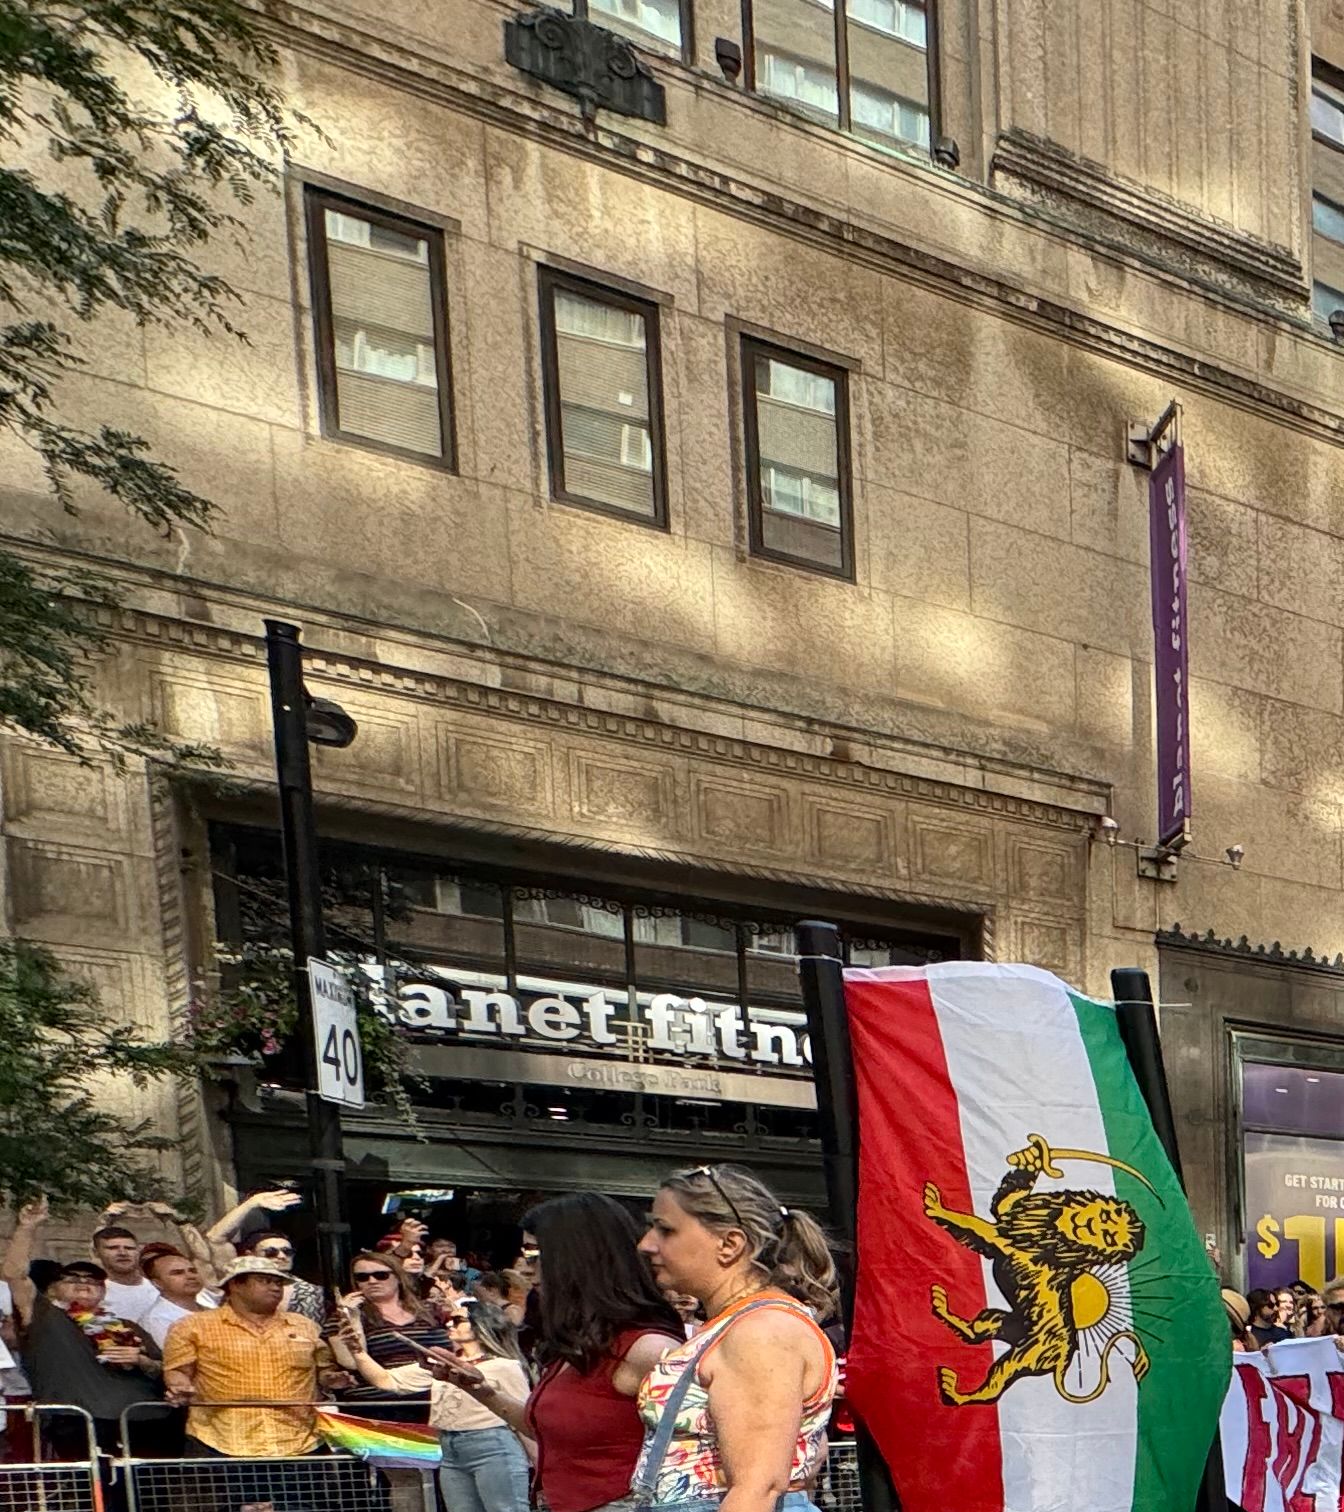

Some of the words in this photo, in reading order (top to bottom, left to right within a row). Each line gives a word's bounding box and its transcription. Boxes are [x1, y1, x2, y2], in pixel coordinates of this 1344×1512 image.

[358, 963, 617, 1043] lanet
[645, 993, 814, 1067] fitn
[323, 1023, 358, 1087] 40
[567, 1061, 659, 1092] College
[662, 1069, 722, 1096] Park
[1285, 1174, 1307, 1189] GET
[1315, 1195, 1338, 1209] FOR
